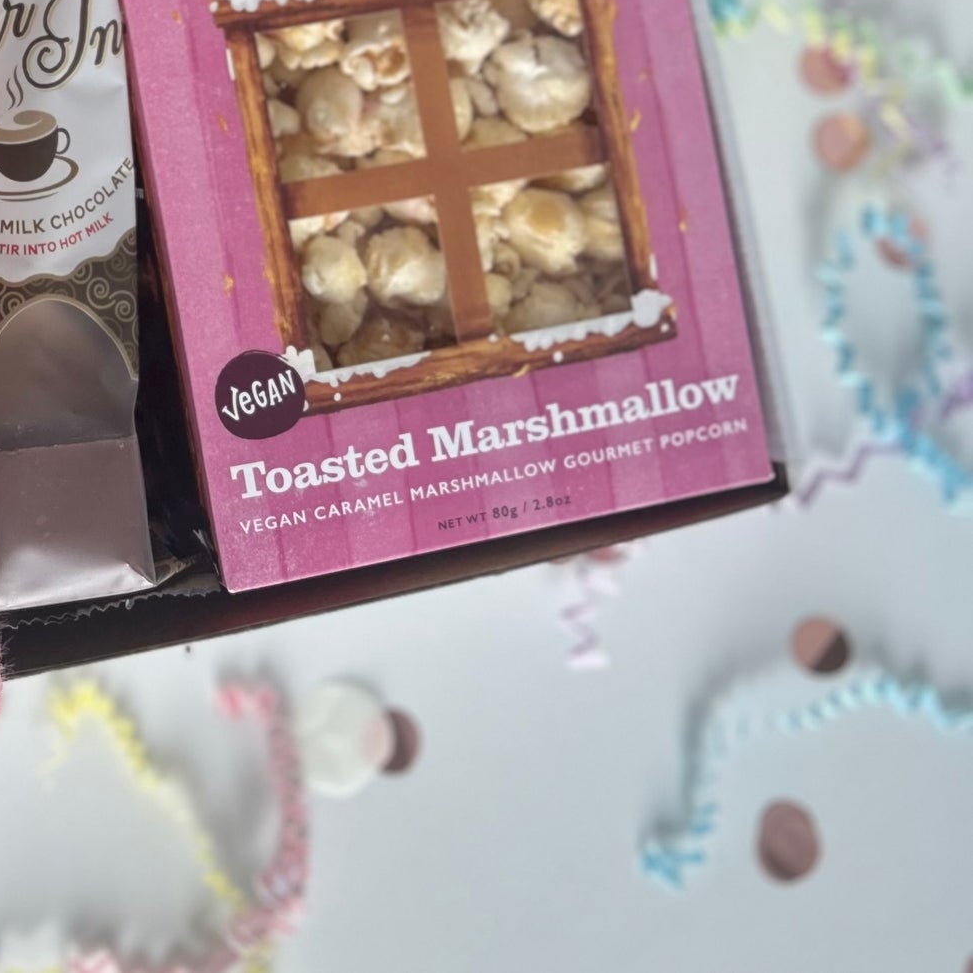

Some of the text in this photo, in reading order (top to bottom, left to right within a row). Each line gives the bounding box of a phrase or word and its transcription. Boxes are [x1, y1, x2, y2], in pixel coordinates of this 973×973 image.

[0, 218, 45, 235] MILK
[50, 156, 135, 231] CHOCOLATE
[23, 238, 57, 256] INTO
[59, 228, 84, 251] HOT
[85, 212, 115, 241] MILK
[230, 373, 740, 500] Toasted Marshmallow
[239, 417, 748, 535] VEGAN CARAMEL MARSHMALLOW GOURMET POPCORN
[438, 516, 462, 532] NET
[466, 510, 487, 525] WT
[491, 503, 518, 522] 80g
[533, 494, 571, 511] 2.8oz
